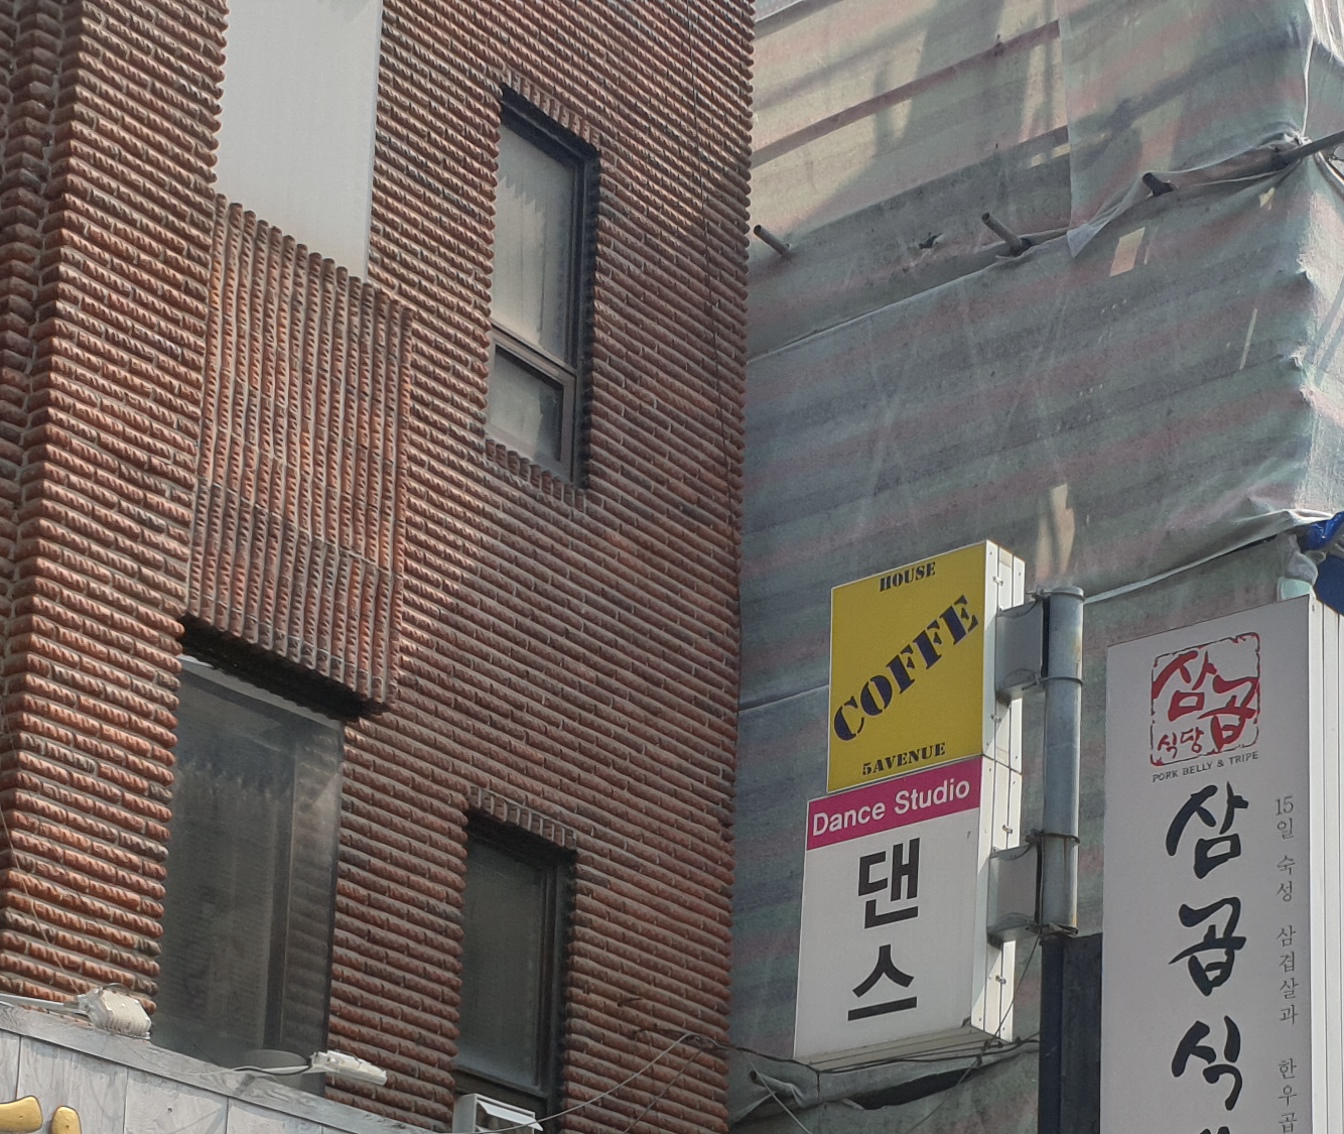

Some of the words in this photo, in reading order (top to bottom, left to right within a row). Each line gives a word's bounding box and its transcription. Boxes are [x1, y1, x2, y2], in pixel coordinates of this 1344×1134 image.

[879, 562, 936, 592] HOUSE
[833, 594, 979, 741] COFFE
[862, 742, 946, 777] 5AVENUE
[1157, 727, 1204, 759] 식당
[1152, 770, 1178, 782] PORK
[1182, 761, 1212, 776] BELLY
[1217, 759, 1225, 768] &
[1228, 751, 1259, 765] TRIPE
[812, 801, 886, 837] Dance
[894, 777, 971, 814] Studio
[1275, 796, 1294, 840] 15일
[1276, 855, 1296, 902] 숙성
[847, 838, 921, 1023] 댄스
[1277, 925, 1299, 1025] 삼겹살과
